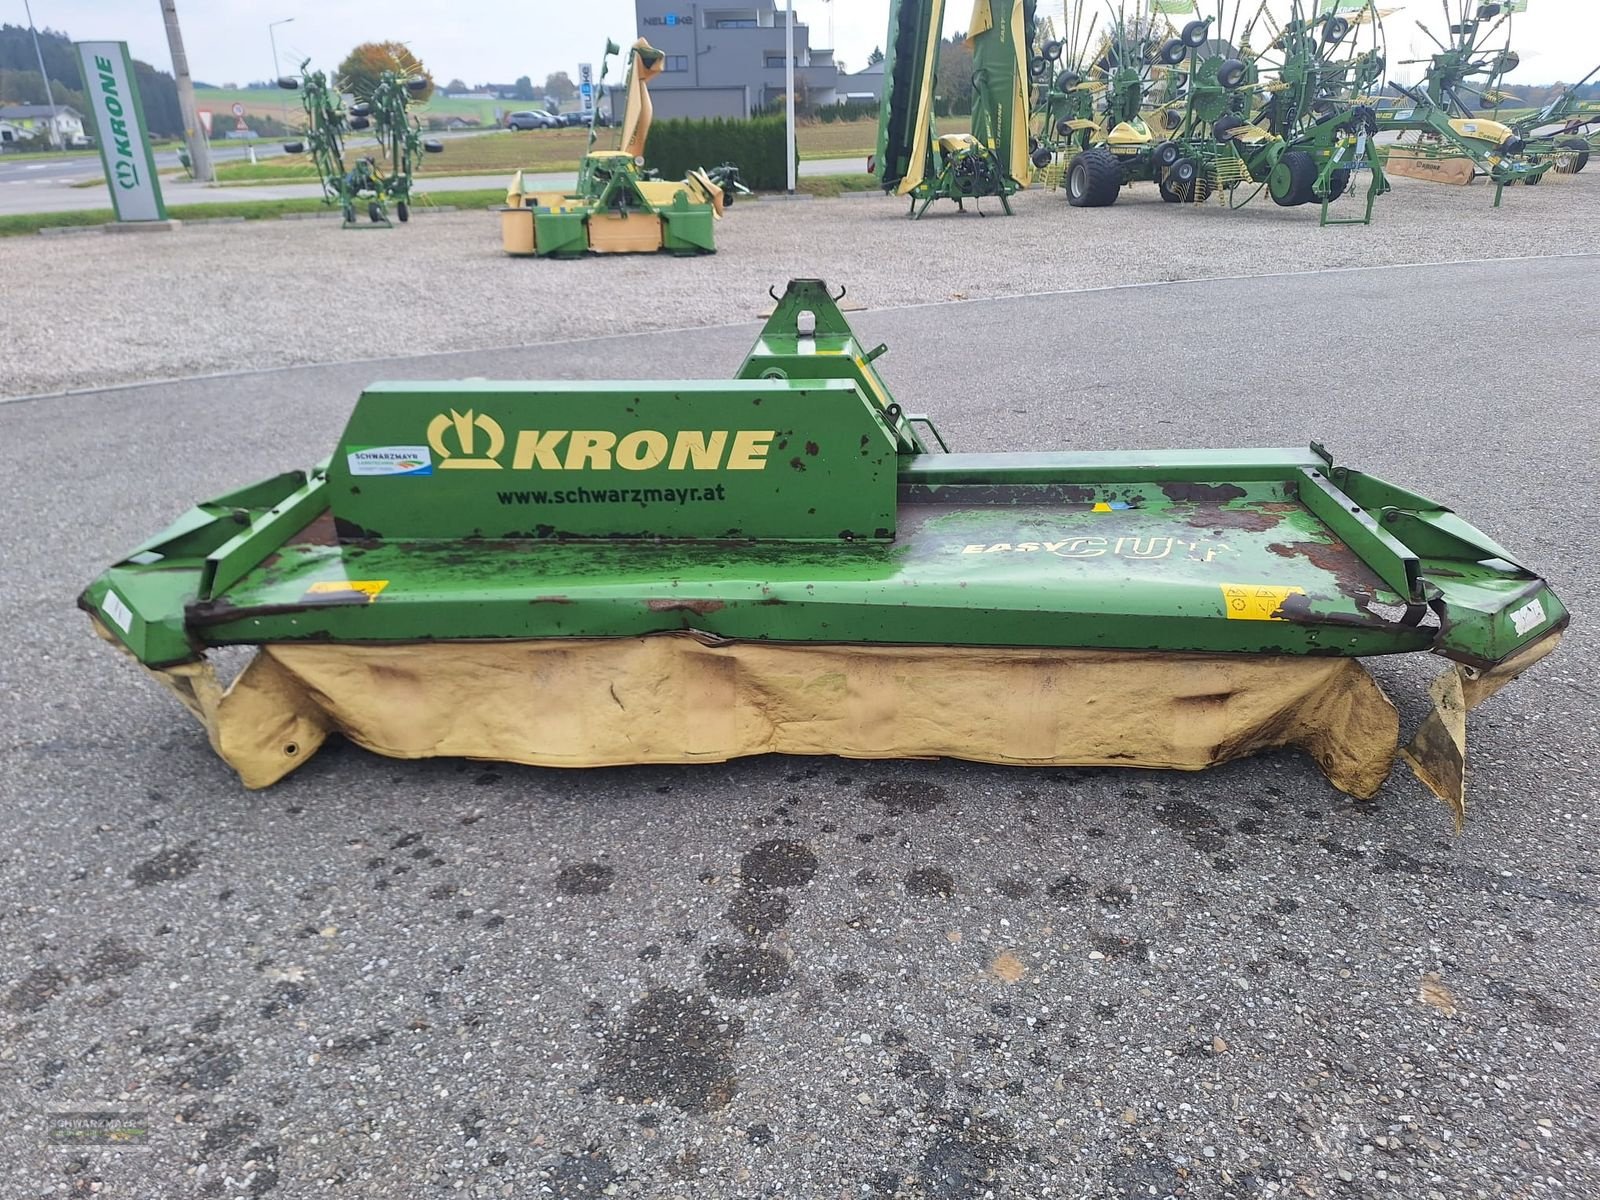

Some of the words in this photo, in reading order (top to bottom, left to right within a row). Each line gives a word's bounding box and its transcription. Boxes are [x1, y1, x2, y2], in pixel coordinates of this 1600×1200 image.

[94, 55, 133, 158] KRONE
[512, 429, 776, 471] KRONE
[497, 483, 725, 506] www.schwarzmayr.at
